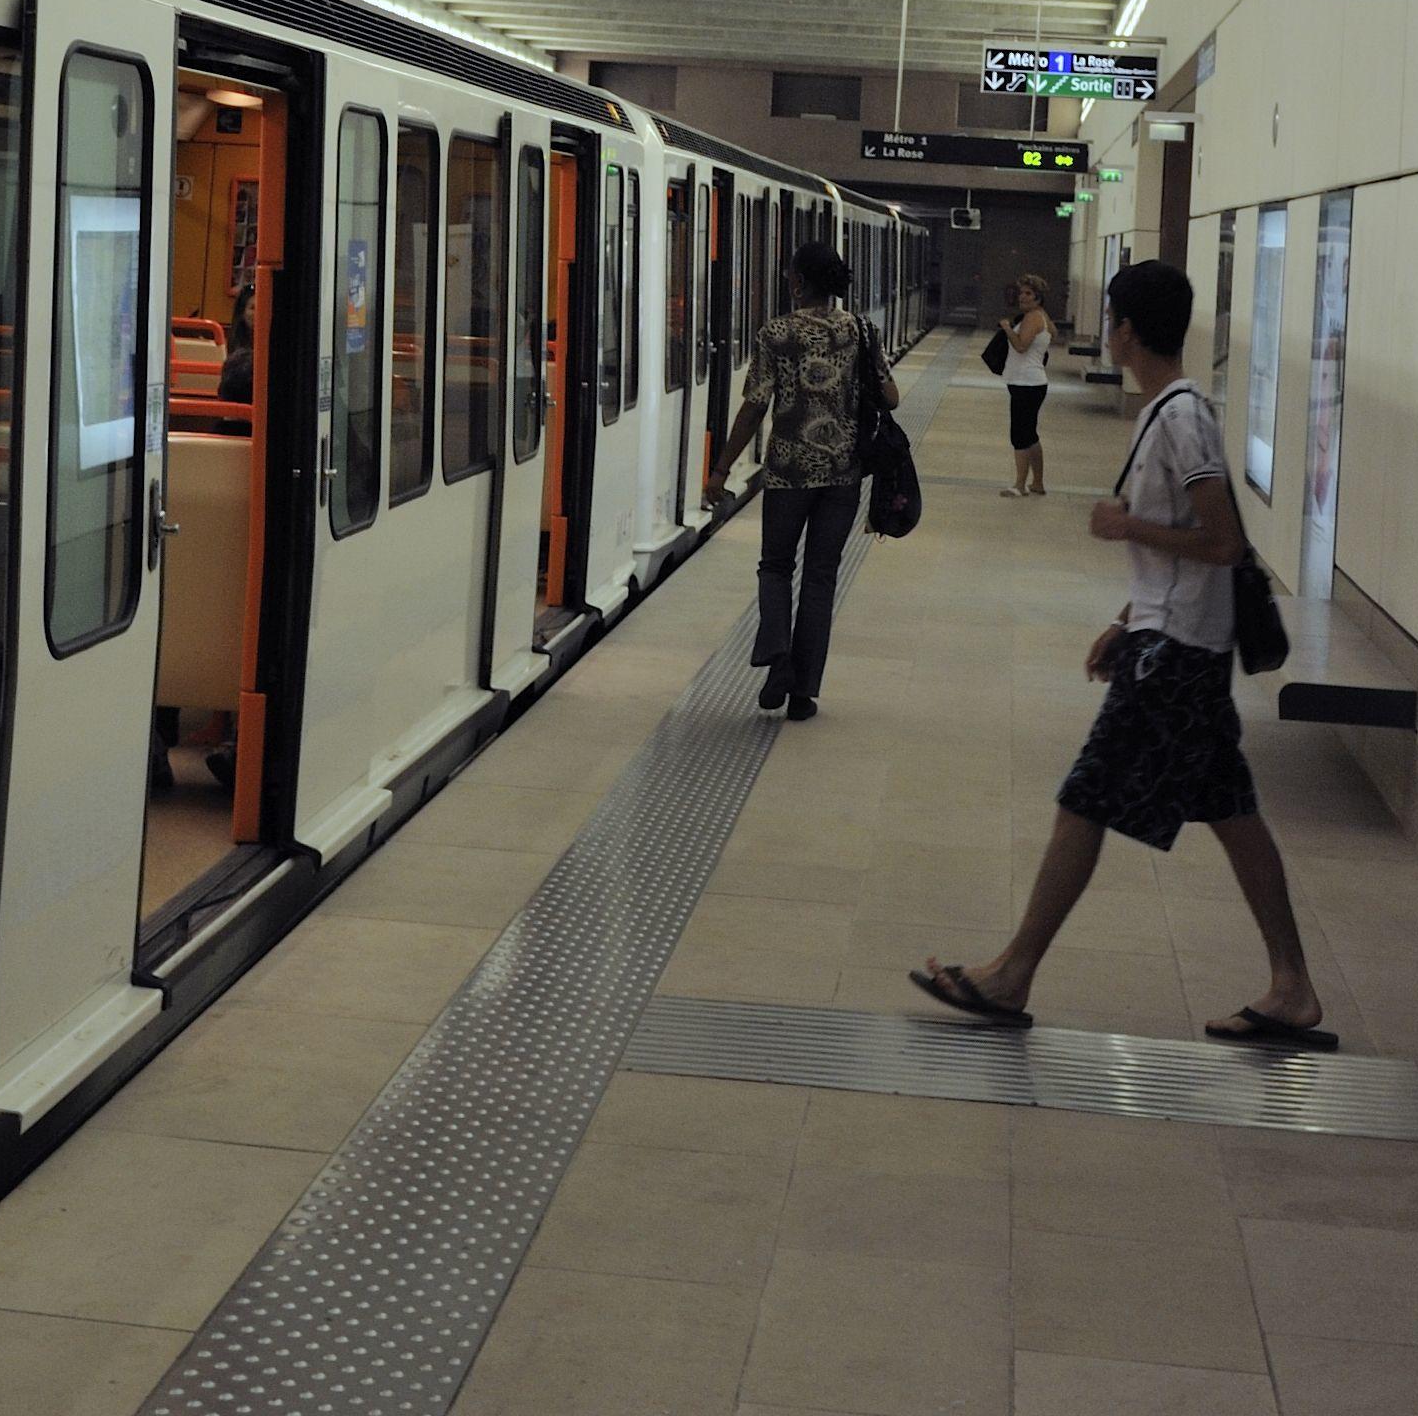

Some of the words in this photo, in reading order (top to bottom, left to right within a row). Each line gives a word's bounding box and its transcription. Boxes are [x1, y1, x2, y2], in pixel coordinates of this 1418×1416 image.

[1008, 51, 1049, 69] Métro
[1054, 54, 1066, 72] 1
[1072, 54, 1086, 68] La
[1087, 55, 1116, 69] Rose
[1070, 78, 1112, 94] Sortie
[884, 133, 915, 145] Métro
[883, 147, 896, 158] La
[898, 148, 925, 161] Rose
